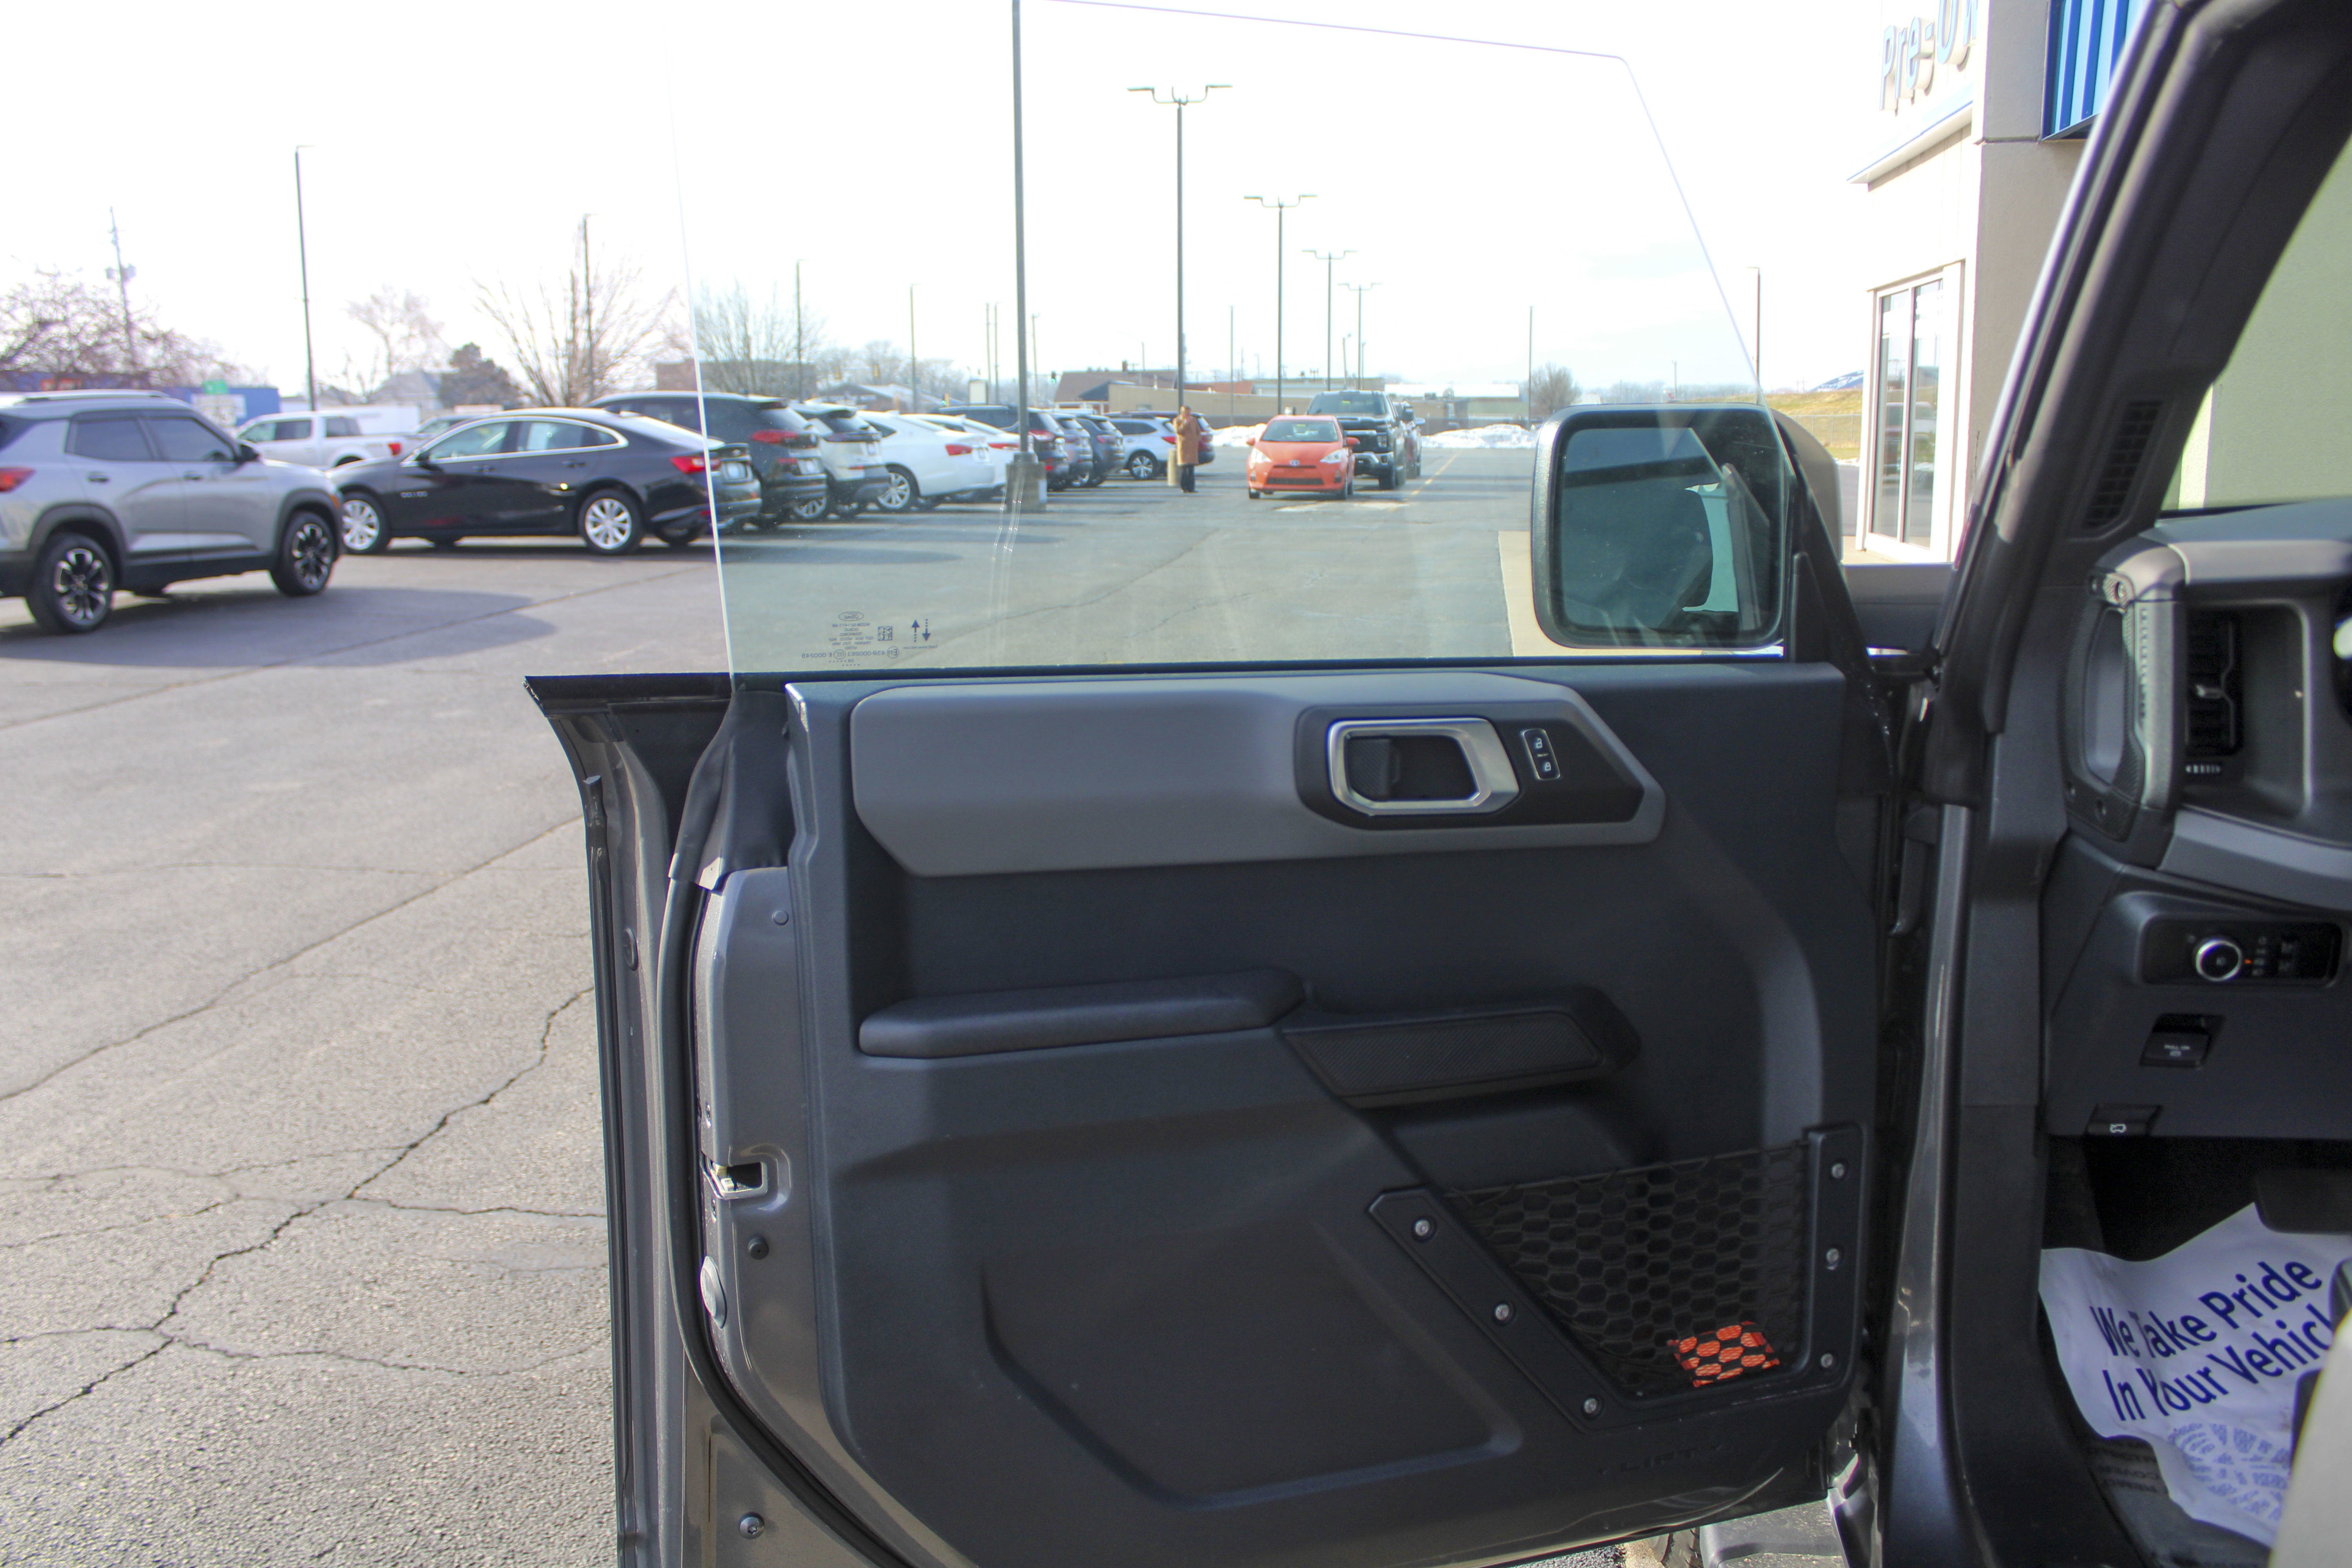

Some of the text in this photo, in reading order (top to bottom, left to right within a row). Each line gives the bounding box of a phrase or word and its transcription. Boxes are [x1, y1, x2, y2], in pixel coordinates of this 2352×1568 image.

[2089, 1261, 2322, 1358] We Take Pride
[2103, 1369, 2146, 1421] In
[2136, 1366, 2229, 1417] Your
